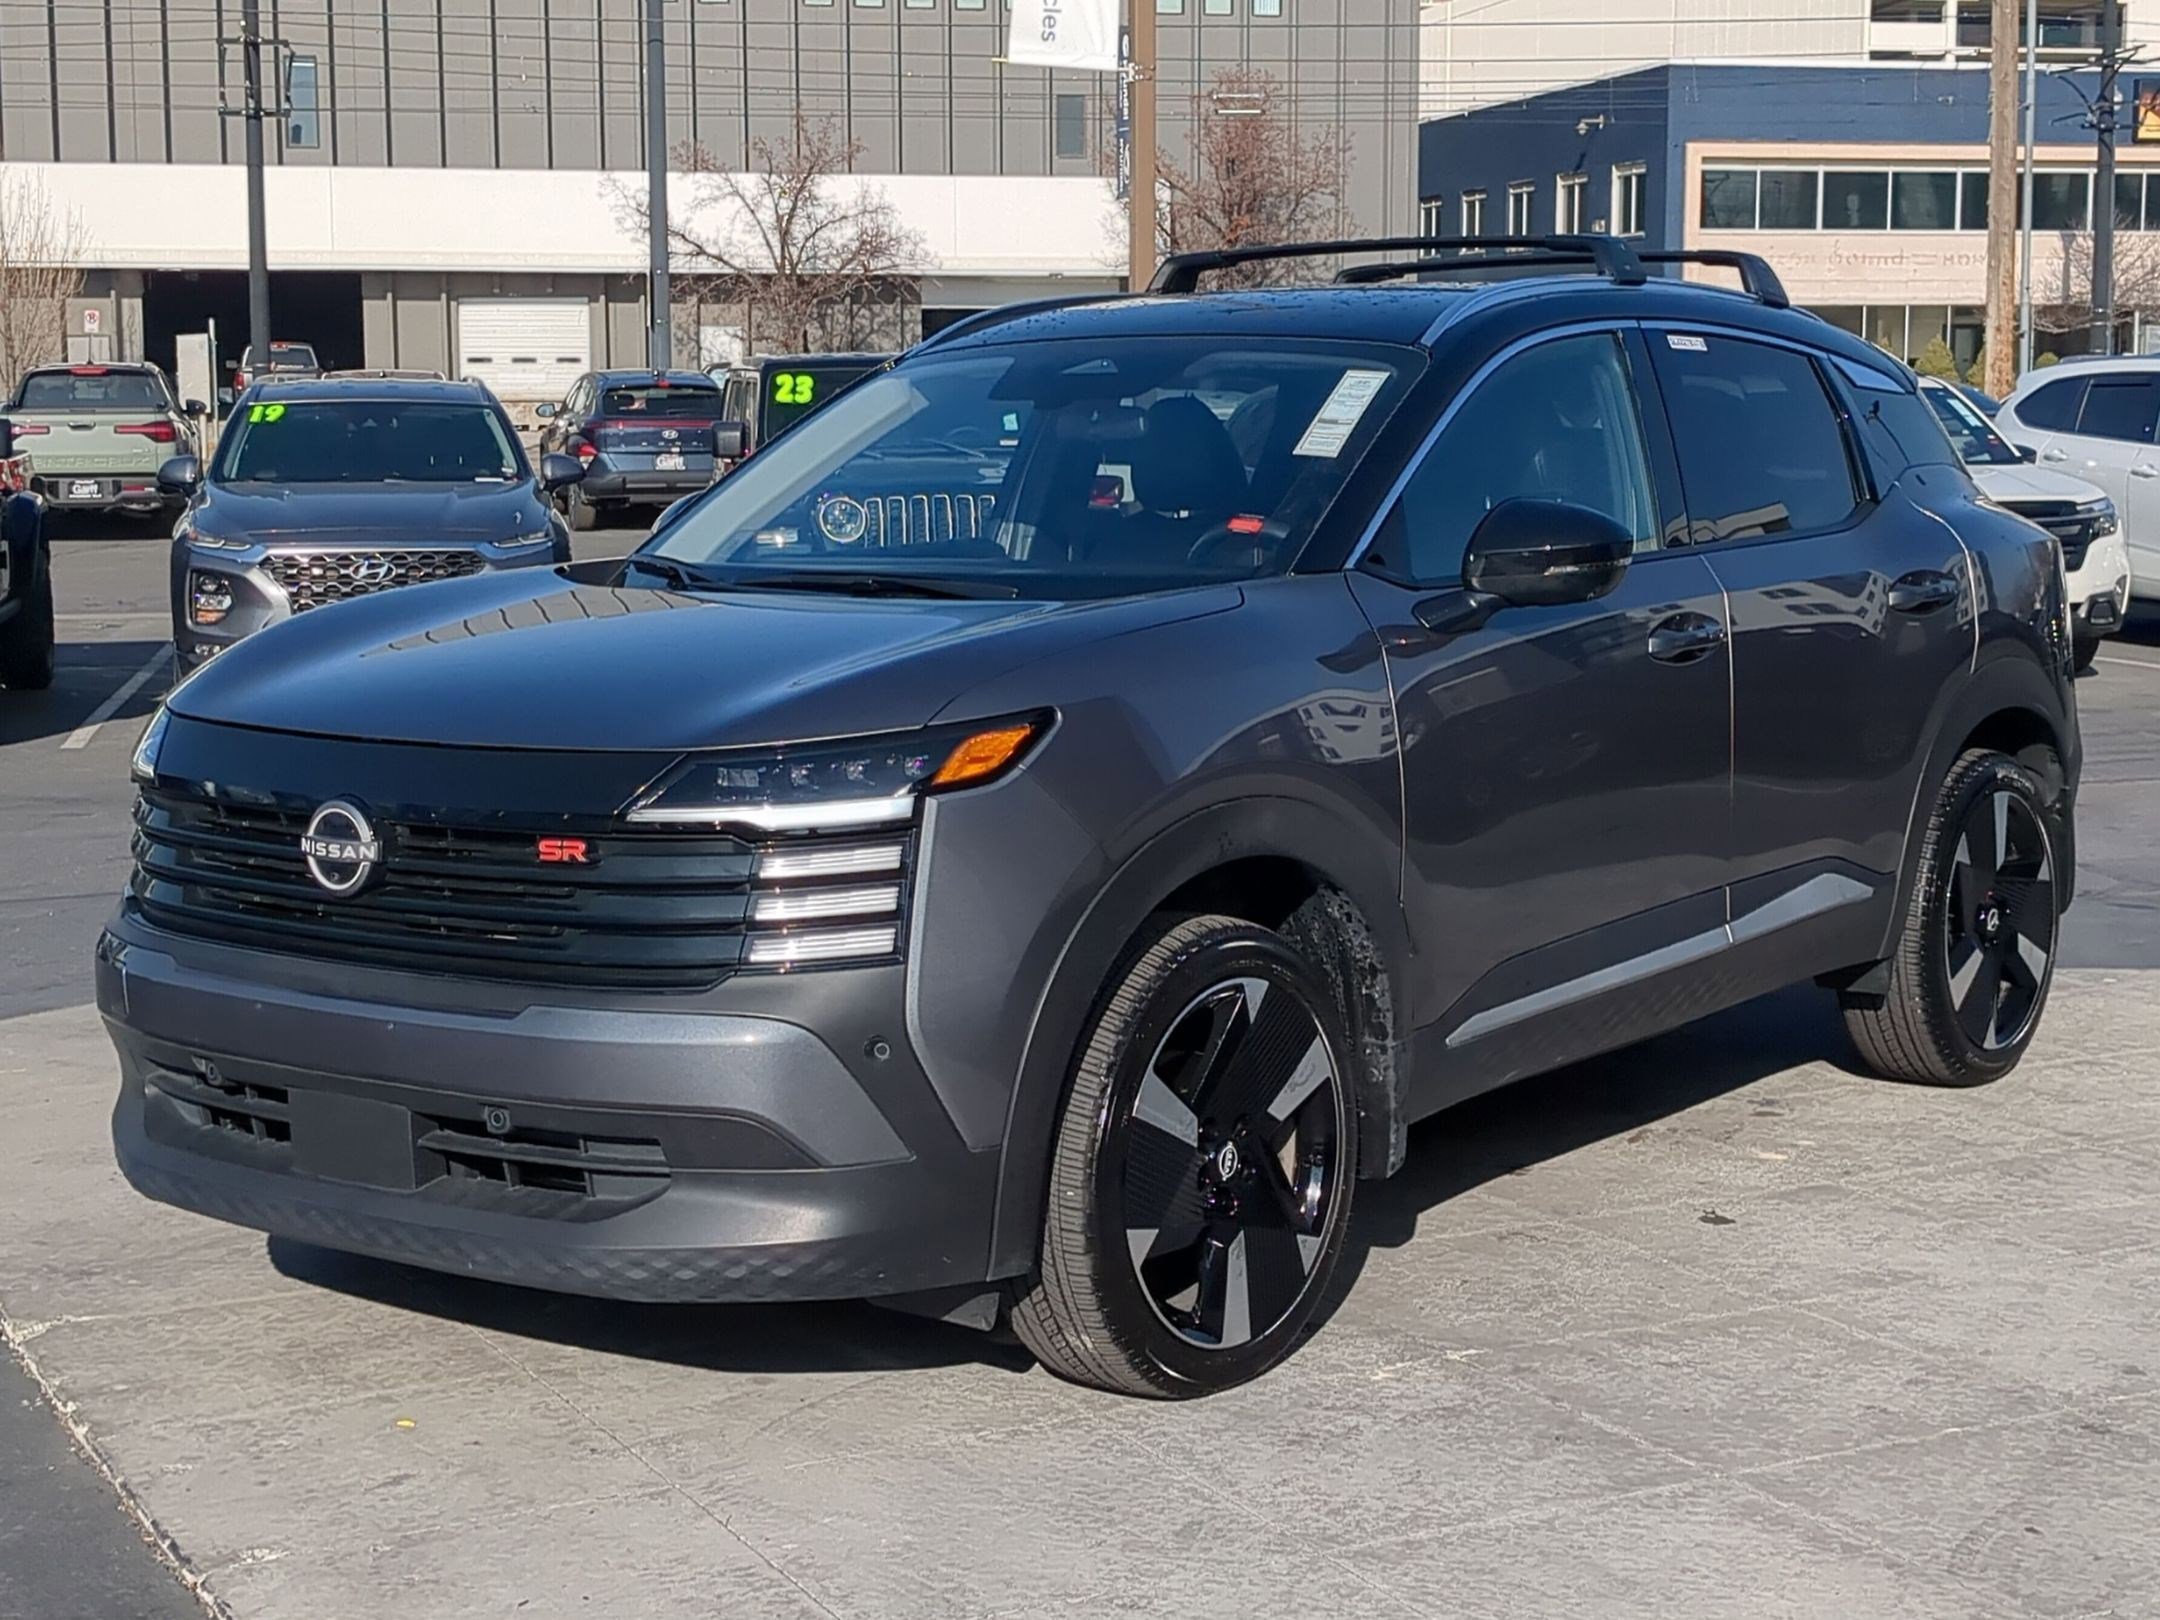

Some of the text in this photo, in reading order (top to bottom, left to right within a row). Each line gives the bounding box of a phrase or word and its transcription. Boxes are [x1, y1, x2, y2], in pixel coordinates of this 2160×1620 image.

[775, 373, 814, 404] 23
[249, 405, 285, 423] 19
[301, 837, 375, 860] NISSAN
[539, 840, 588, 861] SR
